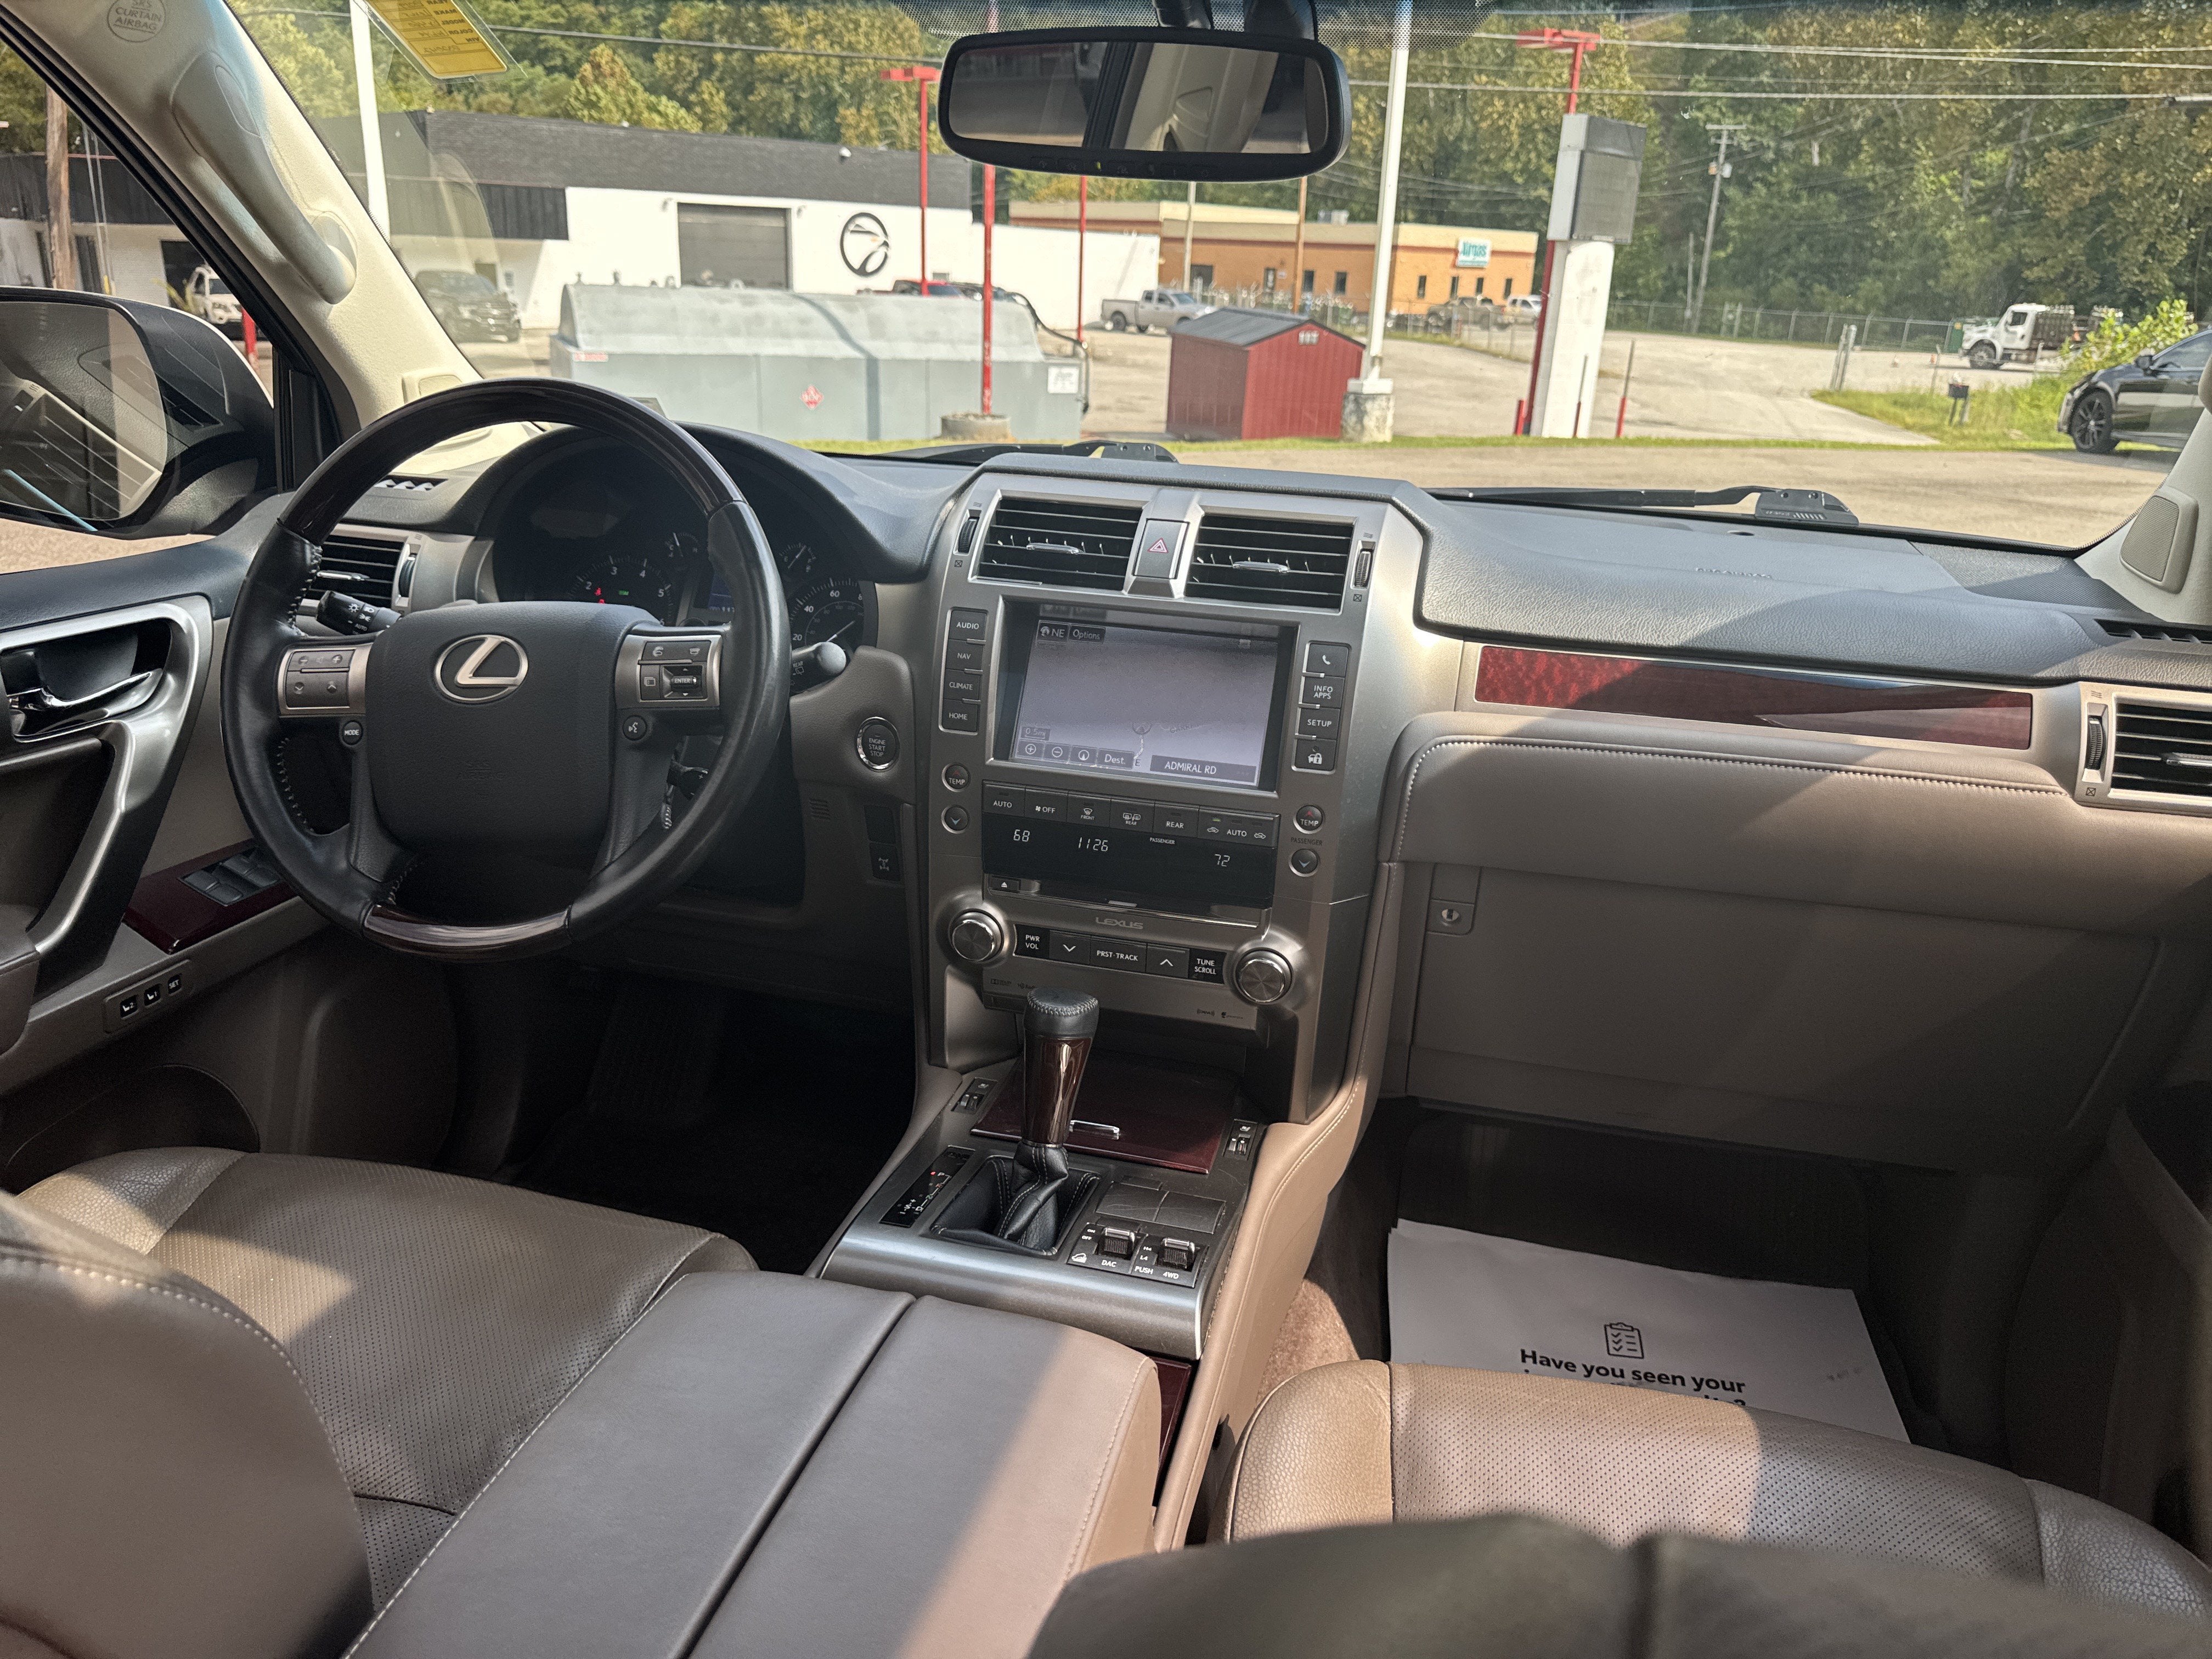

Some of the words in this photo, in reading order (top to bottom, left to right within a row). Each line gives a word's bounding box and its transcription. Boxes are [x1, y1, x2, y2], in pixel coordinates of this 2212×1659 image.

[115, 7, 162, 21] CURTAIN
[114, 16, 157, 30] AIRBAG
[611, 567, 618, 575] 3
[640, 570, 646, 578] 4
[585, 582, 592, 590] 2
[658, 589, 664, 597] 5
[355, 623, 368, 631] AUTO
[956, 622, 979, 630] AUDIO
[1051, 628, 1065, 638] NE
[1073, 629, 1101, 640] Options
[949, 681, 973, 691] CLIMATE
[1313, 685, 1333, 693] INFO
[949, 712, 968, 720] HOME
[1307, 719, 1332, 727] SETUP
[1104, 753, 1126, 765] Dest.
[1164, 761, 1203, 774] ADMIRAL
[1204, 765, 1217, 775] RD
[993, 800, 1012, 808] AUTO
[1166, 821, 1184, 829] REAR
[1300, 819, 1319, 827] TEMP
[1013, 829, 1030, 842] 68
[1226, 829, 1248, 837] AUTO
[1290, 837, 1323, 846] PASSENGER
[1214, 854, 1231, 867] 72
[1096, 917, 1144, 929] LEXUS
[1196, 958, 1215, 967] TUNE
[1194, 966, 1217, 975] SCROLL
[168, 979, 179, 989] SET
[1101, 1260, 1117, 1268] DAC
[1134, 1266, 1154, 1274] PUSH
[1163, 1271, 1180, 1279] 4WD
[1520, 1348, 1577, 1373] Have
[1582, 1363, 1626, 1378] you
[1632, 1368, 1686, 1387] seen
[1690, 1375, 1746, 1393] your
